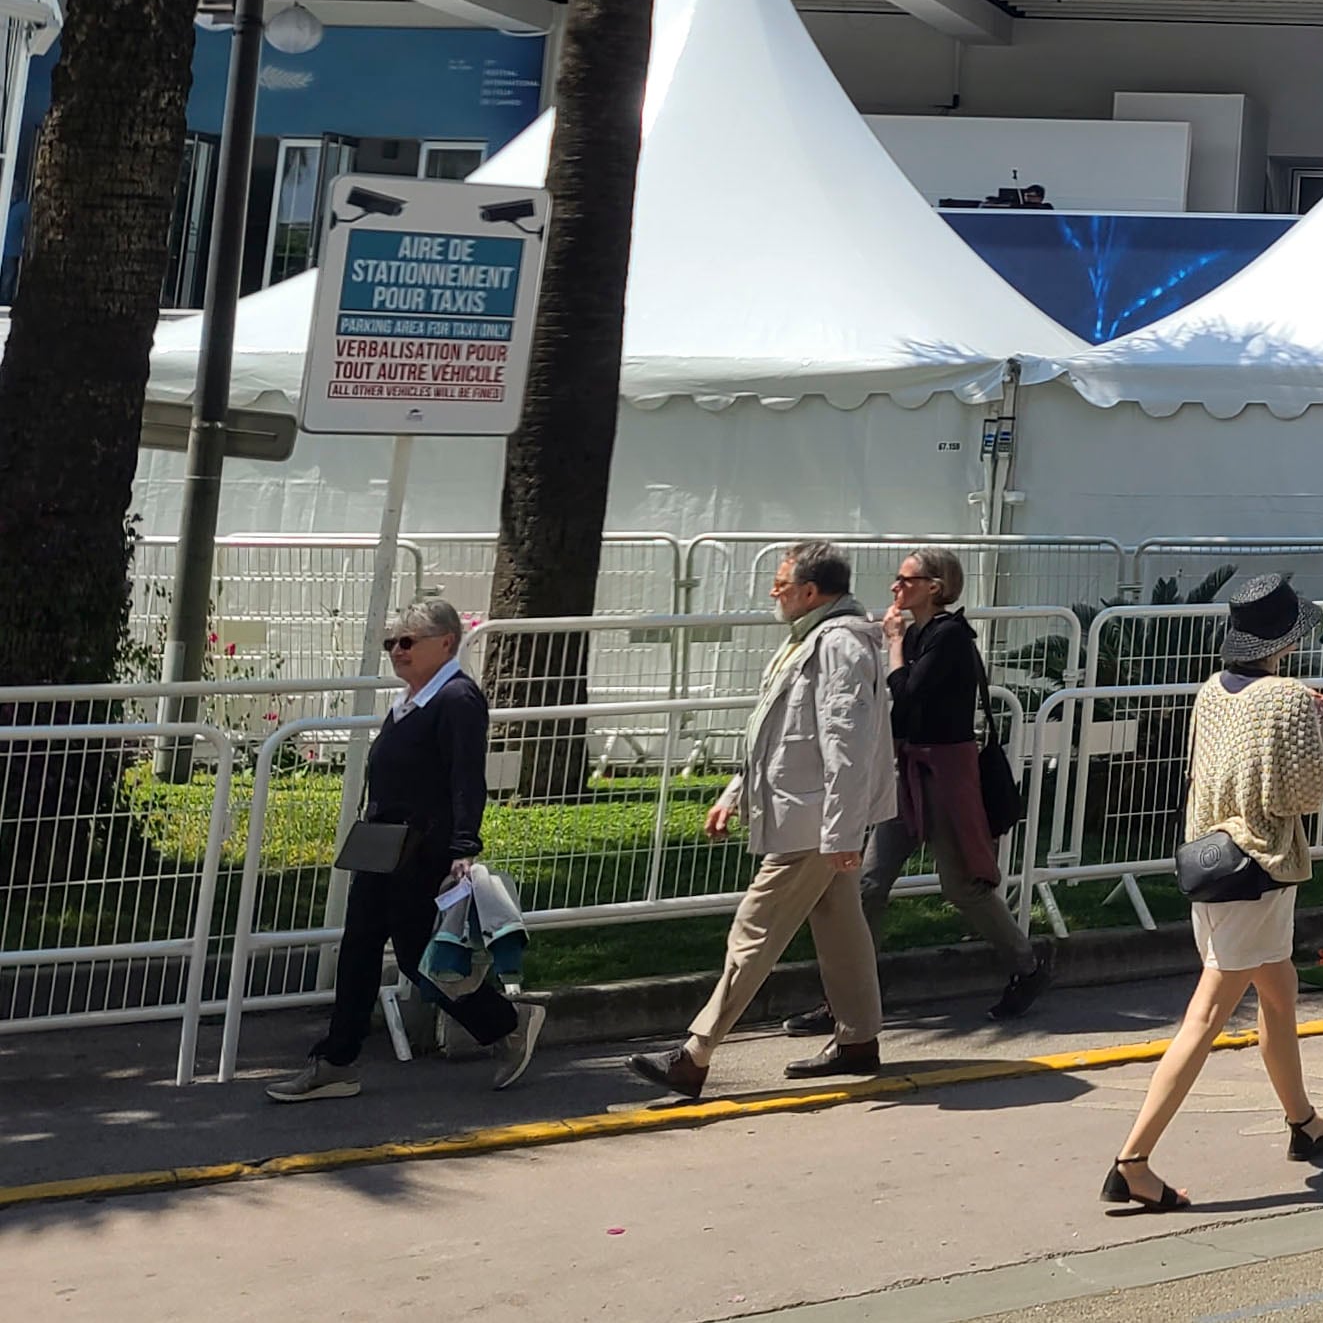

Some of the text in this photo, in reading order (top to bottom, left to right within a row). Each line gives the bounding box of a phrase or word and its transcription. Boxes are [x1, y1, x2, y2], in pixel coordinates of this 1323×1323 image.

[397, 235, 476, 262] AIRE DE
[350, 259, 516, 289] STATIONNEMENT
[371, 285, 488, 313] POUR TAXIS
[340, 317, 392, 334] PARKING
[393, 319, 425, 335] AREA
[427, 321, 450, 336] FOR
[479, 323, 511, 339] ONLY
[336, 339, 508, 362] VERBALISATION POUR
[334, 360, 505, 383] TOUT AUTRE VÉHICULE
[331, 384, 500, 400] ALL OTHER VEHICLES WILL BE FINED
